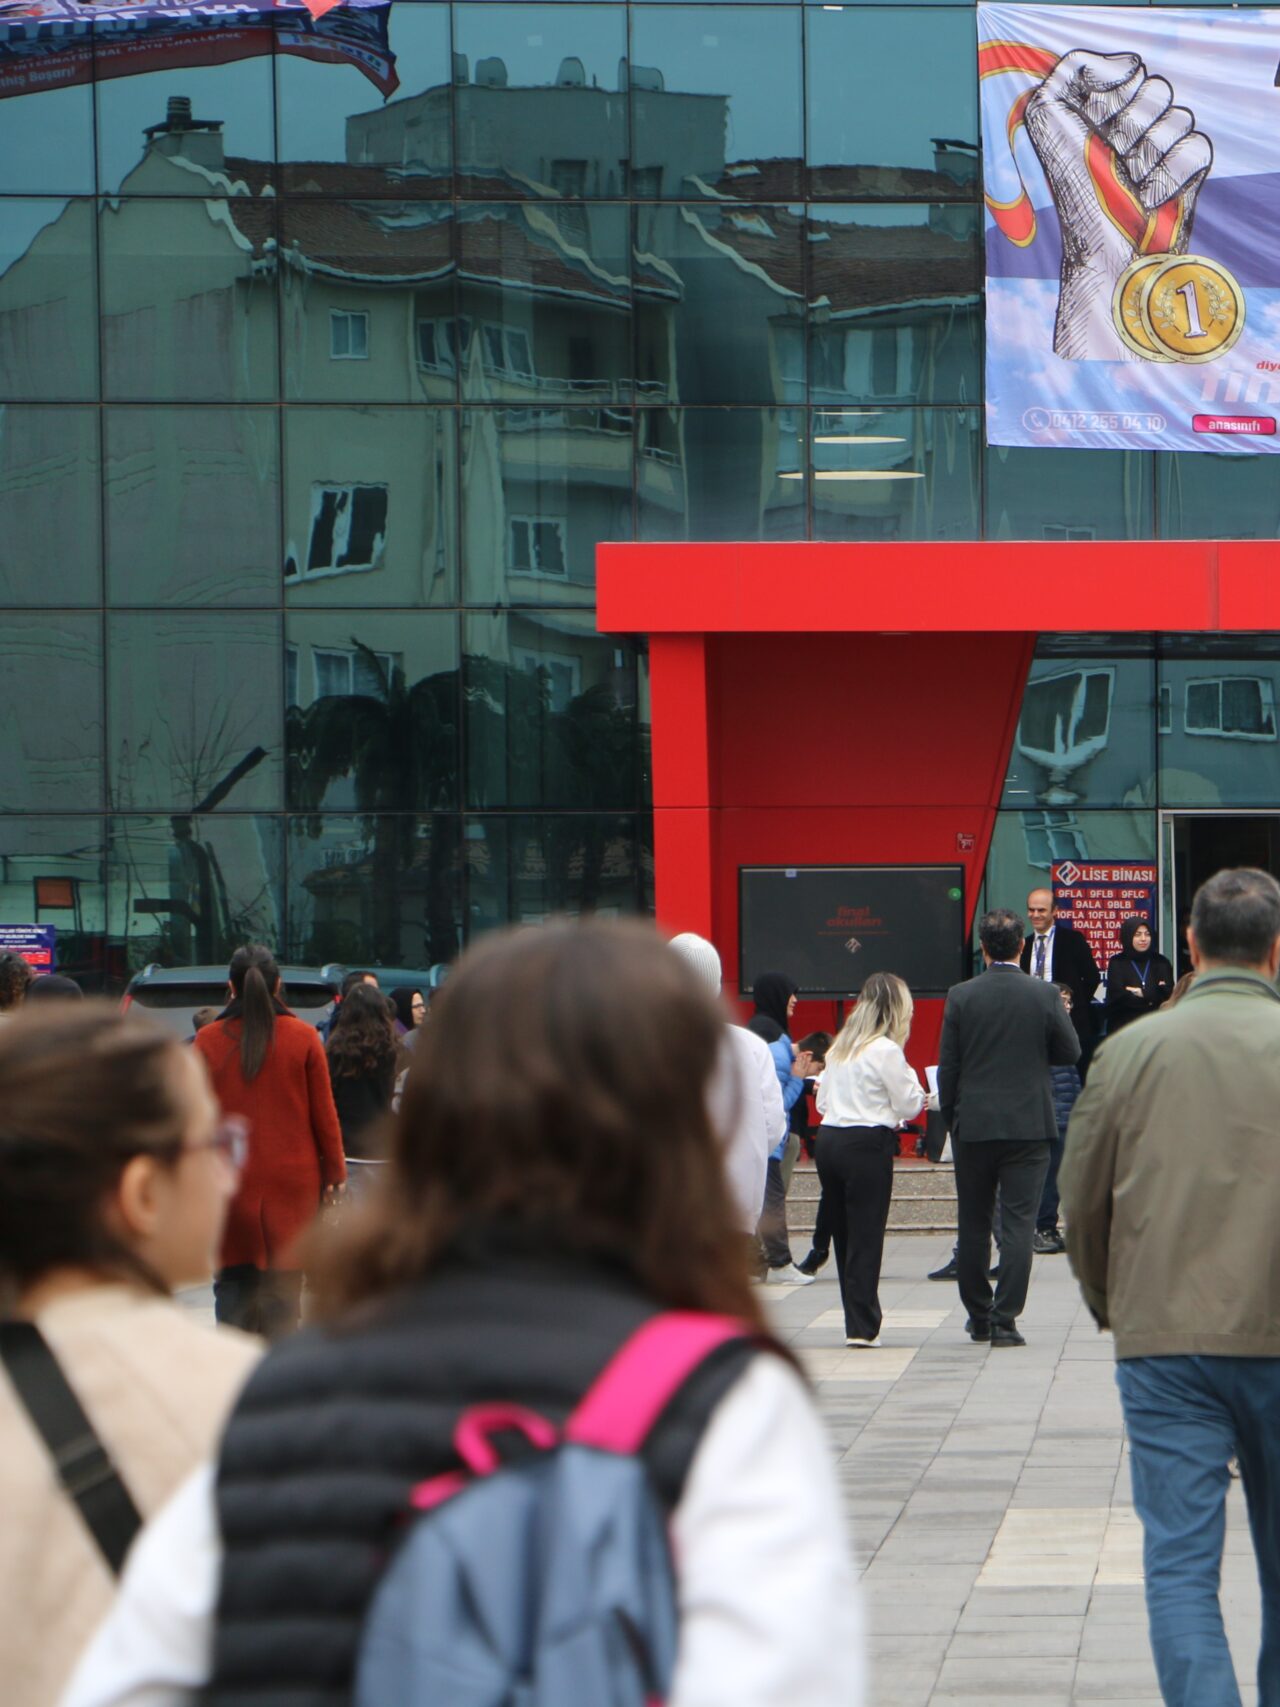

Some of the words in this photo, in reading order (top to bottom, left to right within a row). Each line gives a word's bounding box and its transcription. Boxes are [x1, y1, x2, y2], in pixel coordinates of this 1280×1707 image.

[1053, 413, 1087, 428] 0412
[1090, 414, 1118, 429] 255
[1123, 414, 1142, 430] 04
[1208, 416, 1261, 432] anasınıfı
[1082, 867, 1109, 881] LİSE
[1112, 867, 1153, 881] BİNASI
[1058, 890, 1083, 898] 9FLA
[1089, 890, 1114, 898] 9FLB
[1121, 890, 1145, 899] 9FLC
[1075, 901, 1102, 909] 9ALA
[1107, 901, 1132, 909] 9BLB
[1056, 911, 1085, 919] 10FLA
[1088, 911, 1116, 919] 10FLB
[1073, 921, 1103, 929] 10ALA
[1089, 931, 1115, 939] 11FLB
